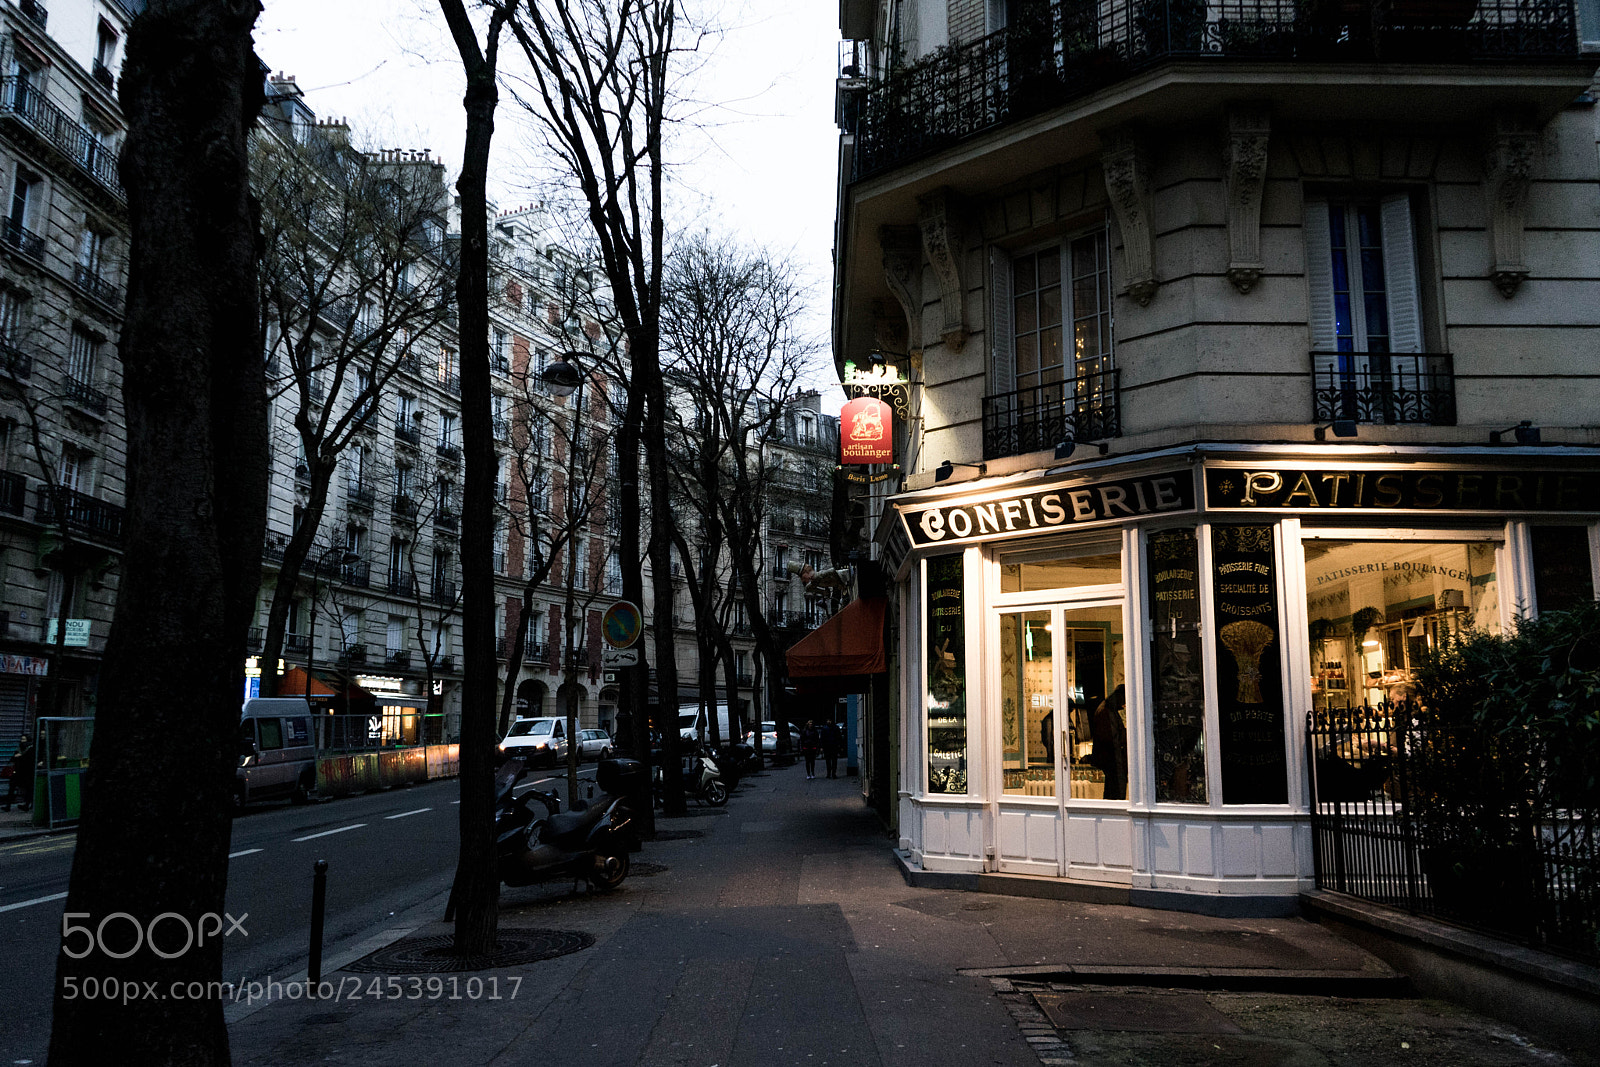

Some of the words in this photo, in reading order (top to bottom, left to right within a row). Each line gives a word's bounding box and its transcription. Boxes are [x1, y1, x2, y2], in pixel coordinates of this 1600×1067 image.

[847, 442, 873, 451] artisan
[843, 447, 891, 460] boulanger
[847, 472, 866, 483] Boris
[1239, 470, 1584, 508] PATISSERIE
[919, 476, 1183, 541] CONFISERIE
[1254, 562, 1271, 576] FINE
[1154, 568, 1195, 584] BOULANGERIE
[1154, 588, 1196, 601] PATISSERIE
[1258, 583, 1270, 594] DE
[1219, 601, 1273, 616] CROISSANTS
[940, 624, 952, 632] DU
